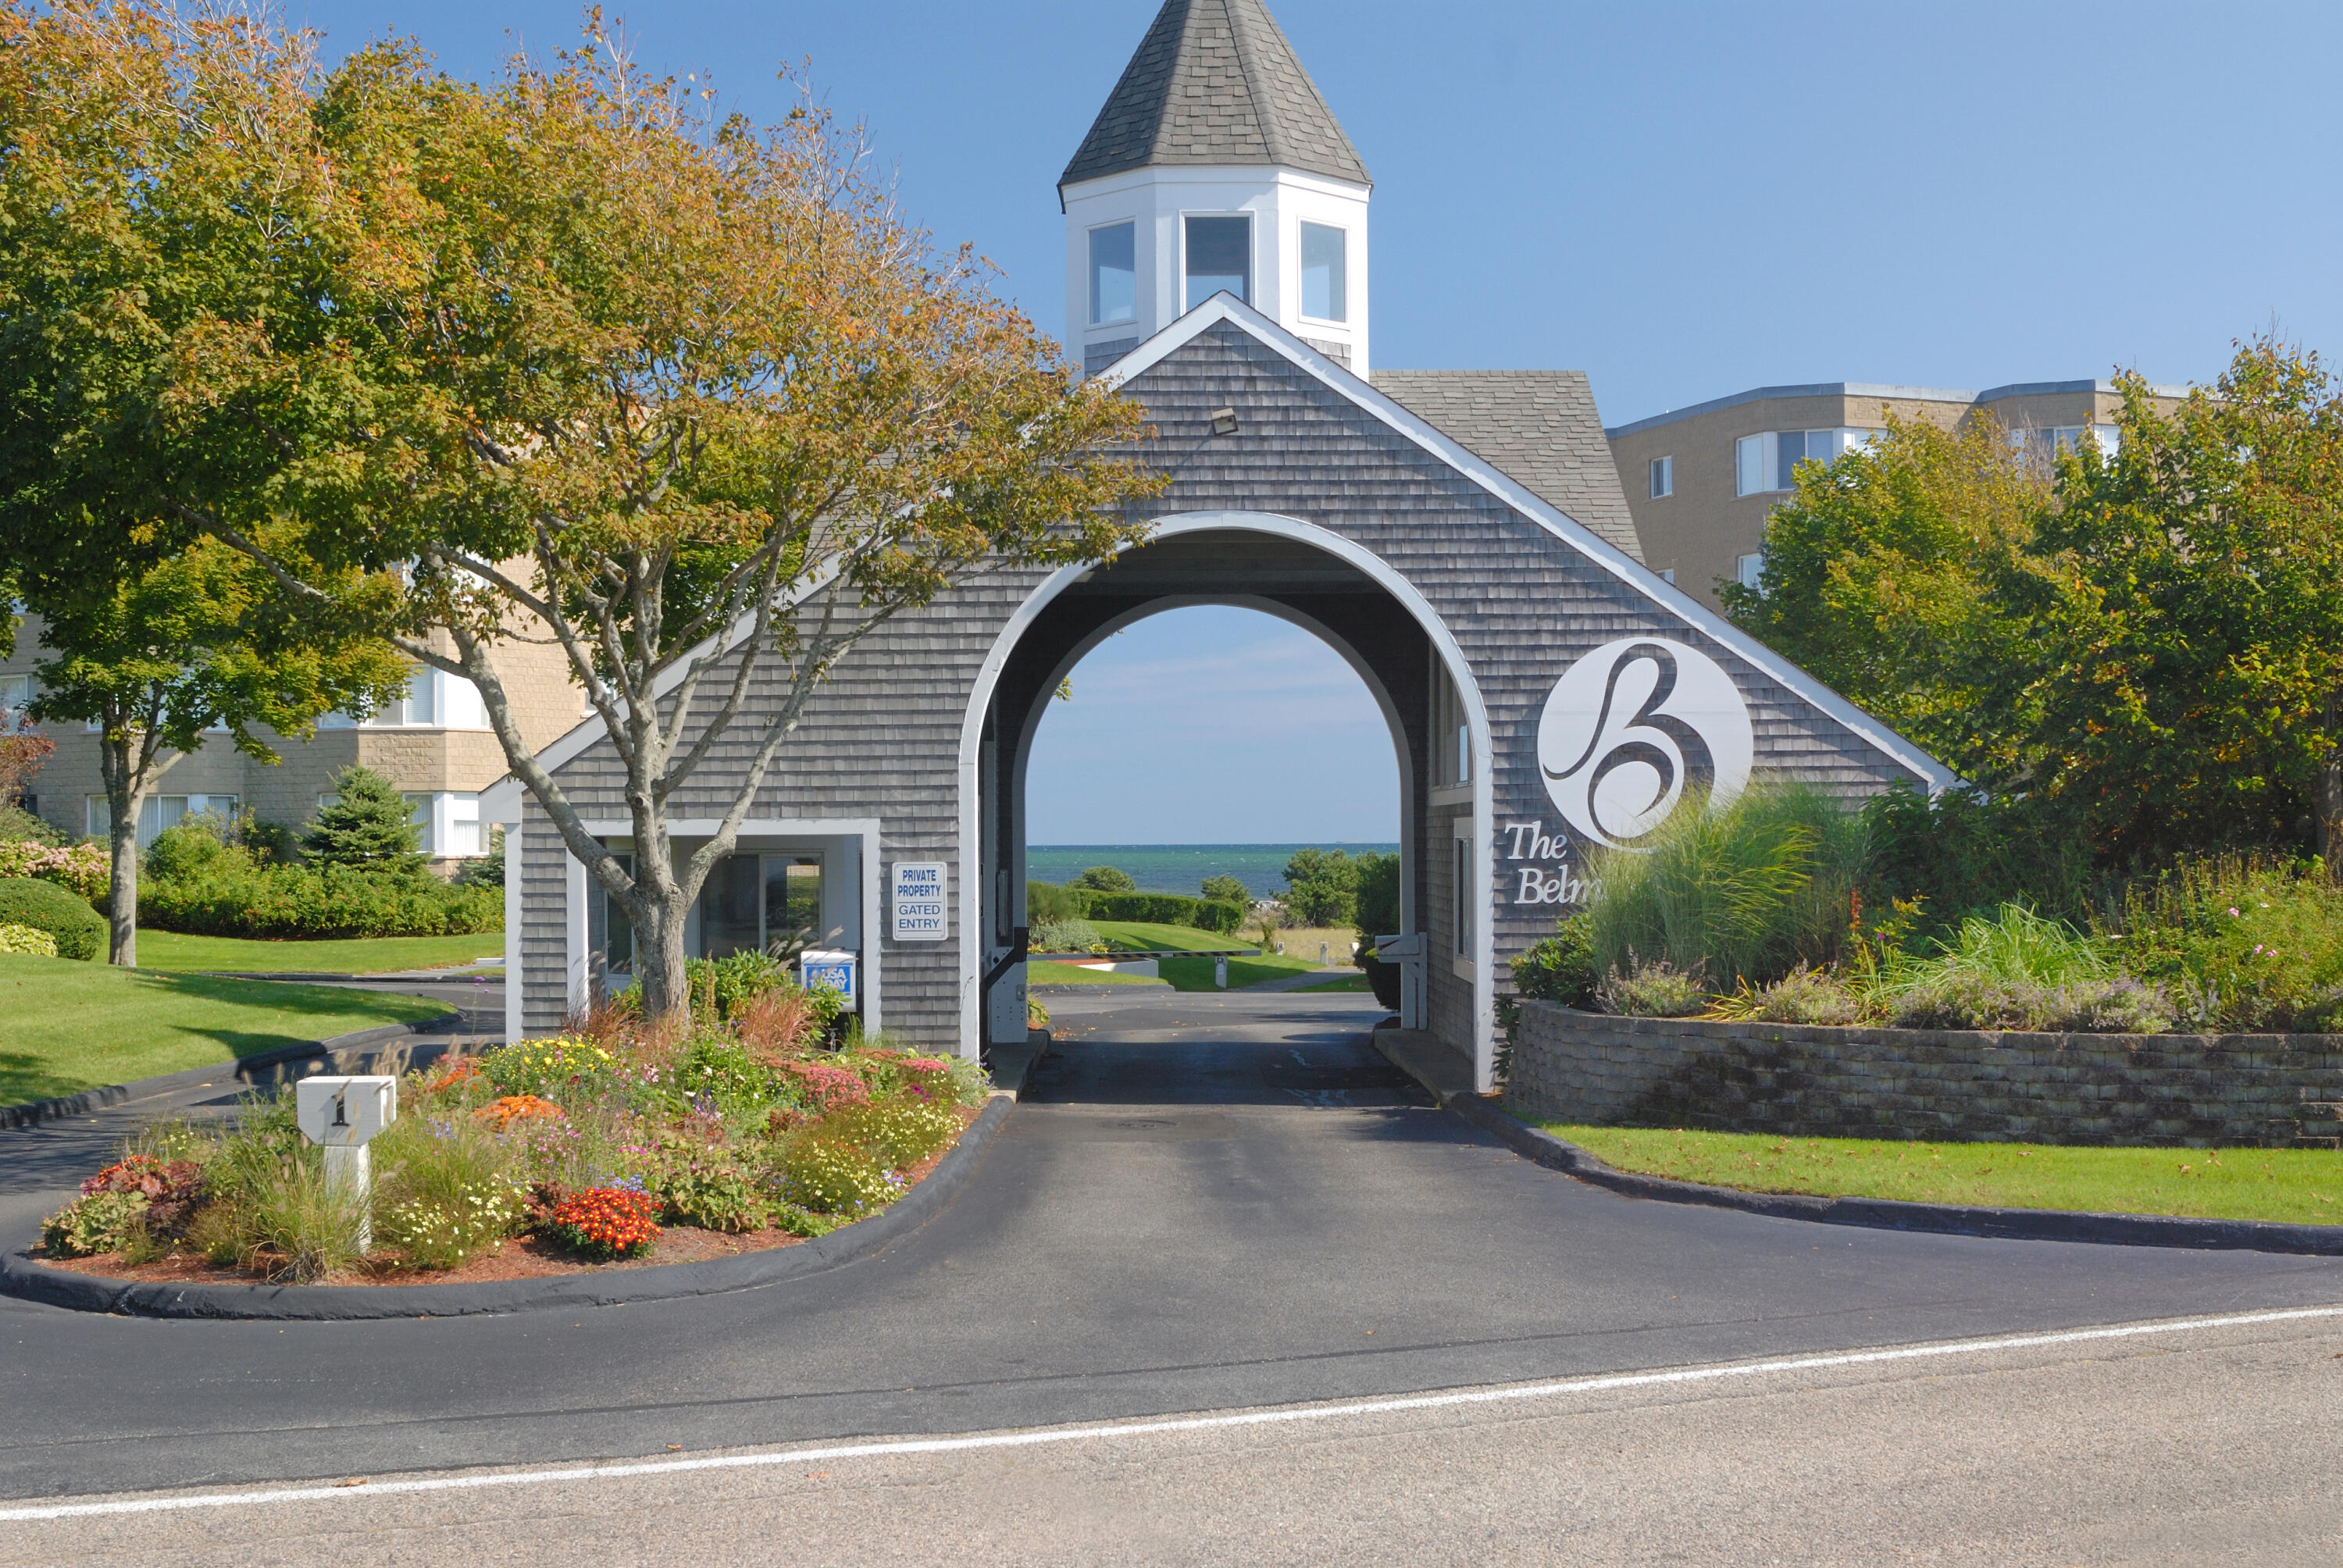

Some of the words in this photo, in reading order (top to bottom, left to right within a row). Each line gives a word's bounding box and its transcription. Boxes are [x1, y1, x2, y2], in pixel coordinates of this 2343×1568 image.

[1504, 820, 1567, 860] The
[902, 869, 936, 882] PRIVATE
[1514, 864, 1604, 904] Belm
[897, 885, 941, 896] PROPERTY
[899, 905, 940, 915] GATED
[899, 918, 940, 928] ENTRY
[822, 968, 847, 979] USA
[809, 978, 848, 989] TDAY
[331, 1087, 350, 1127] 1
